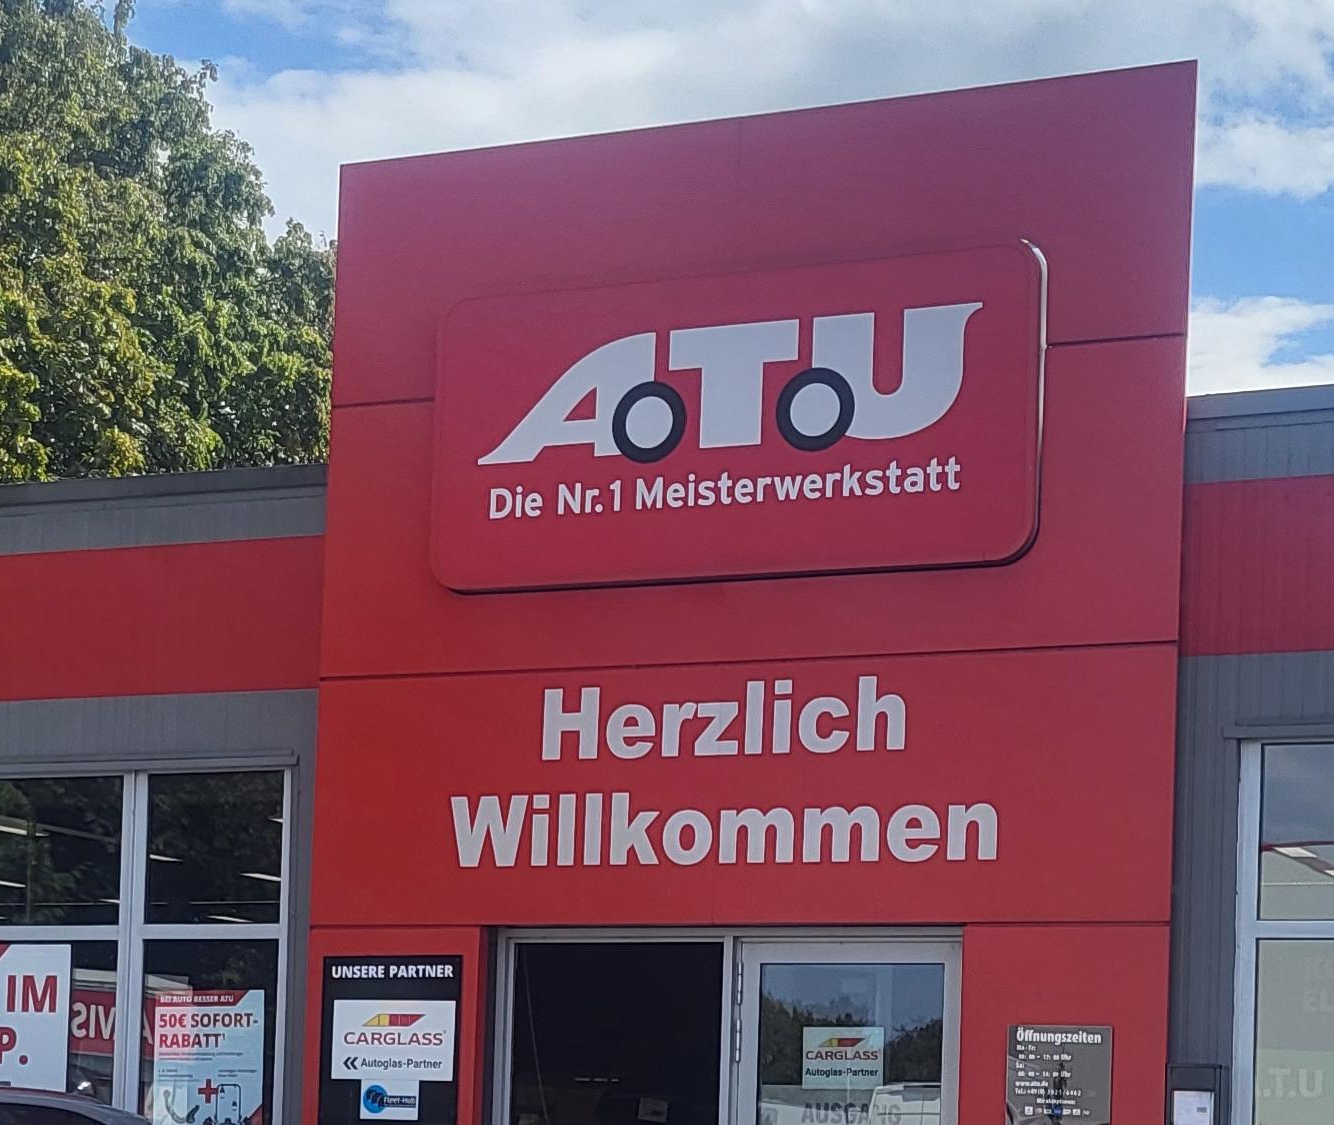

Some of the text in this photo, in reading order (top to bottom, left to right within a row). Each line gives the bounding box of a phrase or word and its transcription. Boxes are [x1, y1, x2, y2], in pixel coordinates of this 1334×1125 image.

[477, 301, 983, 465] ATU
[488, 456, 962, 520] Die Nr.1 Meisterwerkstatt
[541, 675, 907, 761] Herzlich
[450, 791, 999, 868] Willkommen
[331, 964, 454, 979] UNSERE PARTNER
[6, 975, 58, 1013] IM
[172, 995, 192, 1003] AUTO
[220, 994, 234, 1003] ATU
[159, 1012, 258, 1029] 50€ SOFORT-
[1016, 1027, 1102, 1045] Öffnungszeiten
[360, 1057, 443, 1072] Autoglas-Partner
[805, 1067, 879, 1078] Autoglas-Partner
